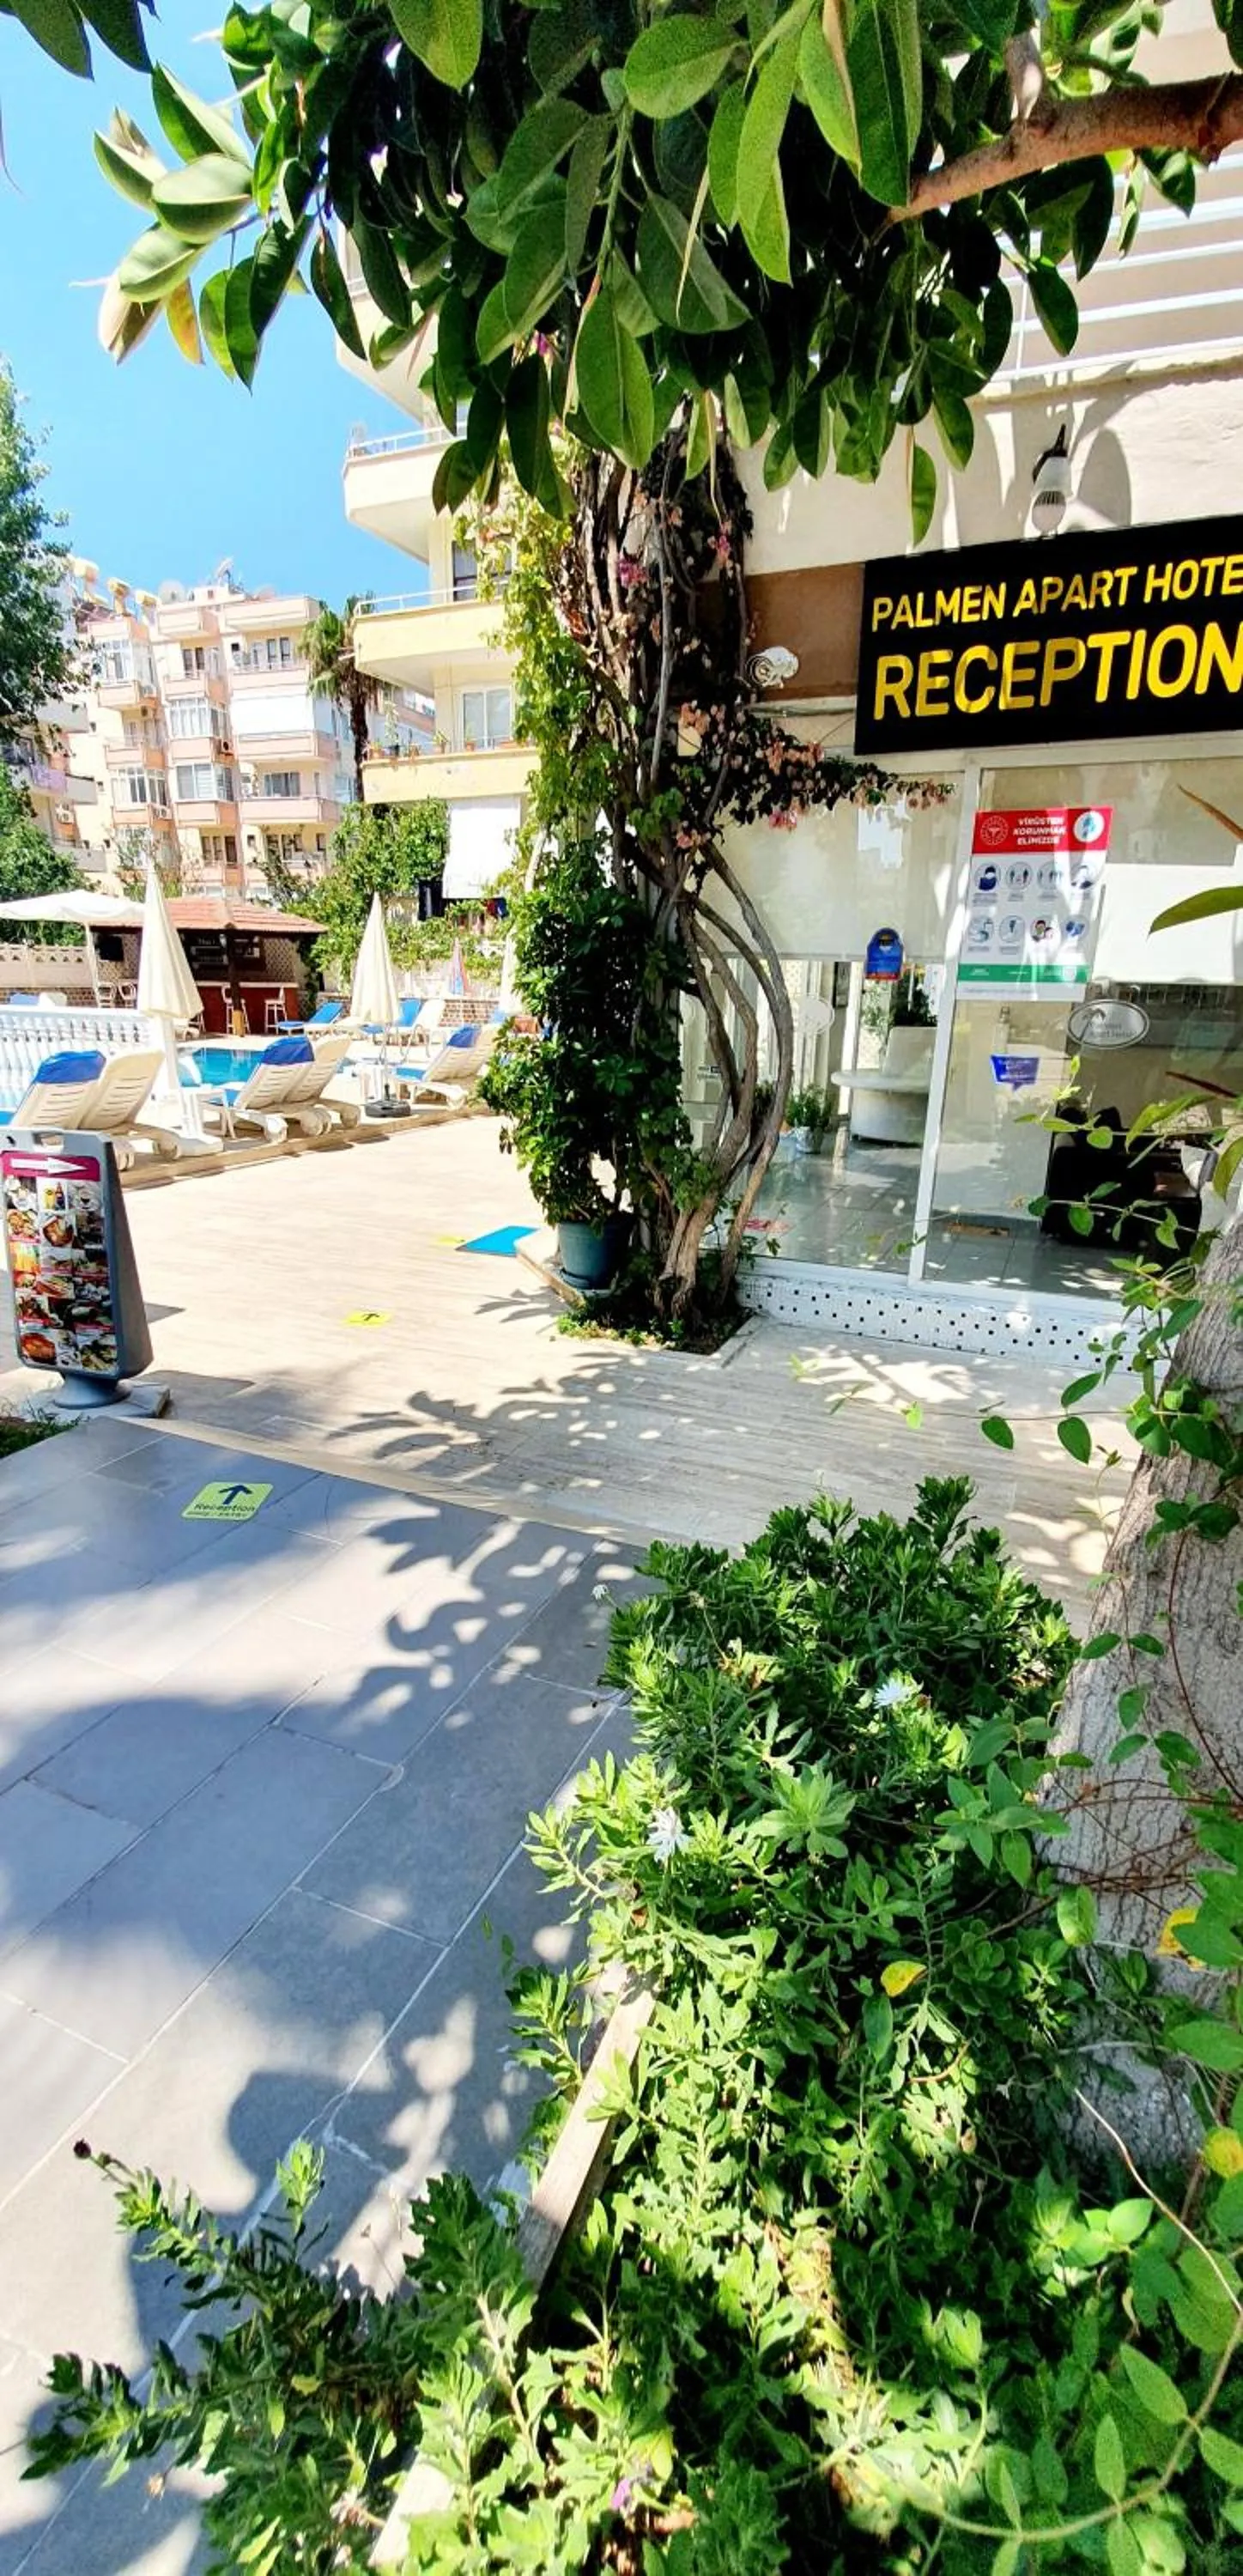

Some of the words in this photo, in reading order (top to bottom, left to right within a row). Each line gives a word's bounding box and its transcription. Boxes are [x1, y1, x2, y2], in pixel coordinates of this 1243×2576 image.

[872, 582, 1007, 632] PALMEN
[1013, 567, 1137, 617] APART
[874, 621, 1243, 720] RECEPTION
